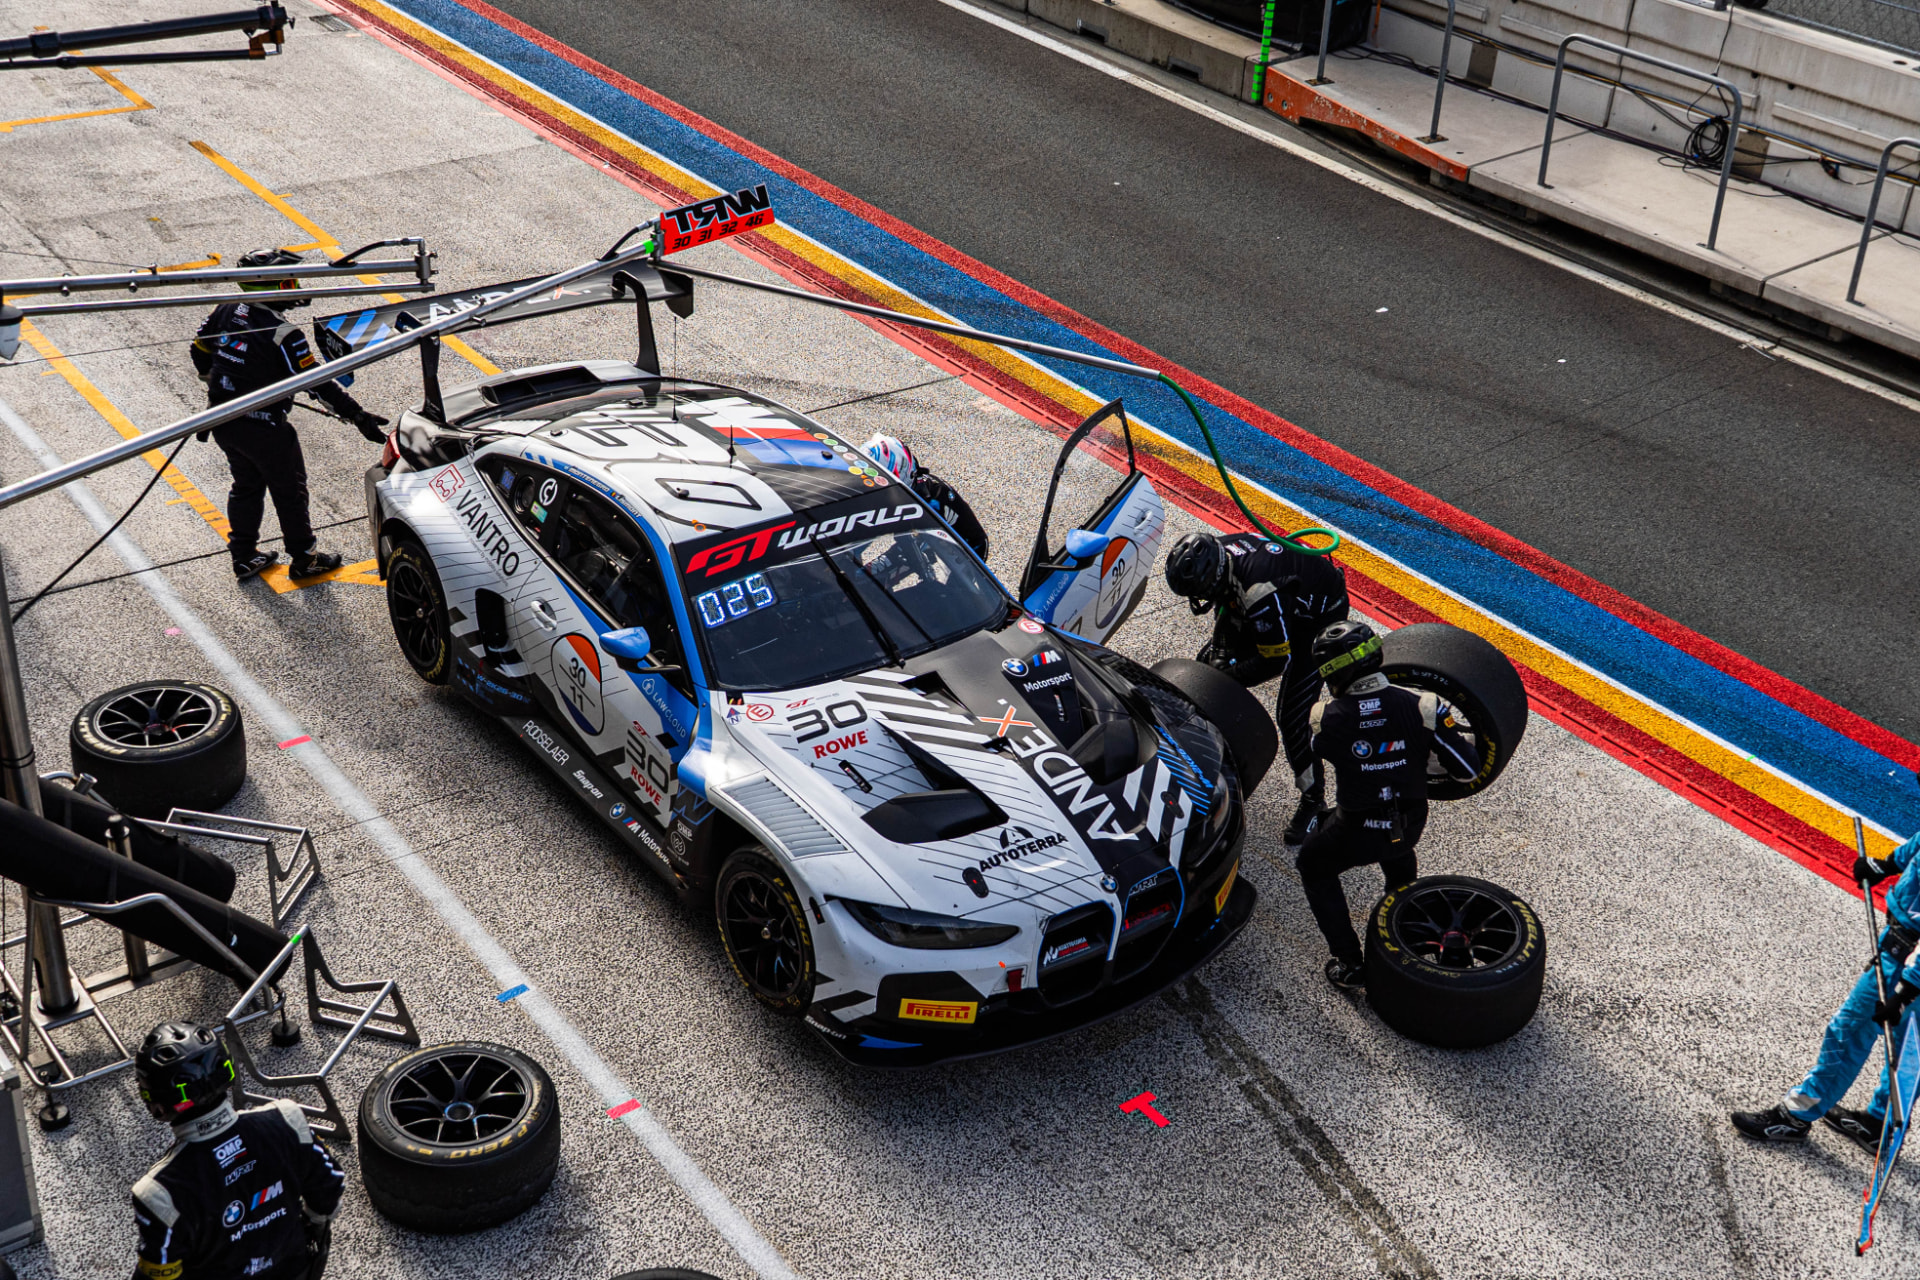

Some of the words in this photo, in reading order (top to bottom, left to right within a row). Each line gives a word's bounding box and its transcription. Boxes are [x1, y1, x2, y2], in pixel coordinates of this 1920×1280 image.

[672, 235, 692, 250] 30
[697, 228, 713, 243] 31
[719, 221, 738, 236] 32
[744, 213, 764, 228] 46
[456, 488, 520, 577] VANTRO
[685, 520, 797, 577] GT
[777, 503, 924, 549] WORLD
[1111, 558, 1126, 586] 30
[698, 572, 775, 628] 025
[568, 657, 587, 689] 30
[1023, 672, 1073, 692] Motorsport
[569, 685, 584, 712] 11
[653, 692, 687, 738] LAWCLOUD
[1358, 700, 1381, 711] OMP
[786, 700, 868, 744] 30
[522, 719, 570, 766] ROOSELAER
[626, 729, 669, 794] 30
[812, 730, 868, 759] ROWE
[1361, 759, 1407, 772] Motorsport
[630, 765, 662, 806] ROWE
[978, 833, 1069, 873] AUTOTERRA
[1377, 895, 1395, 939] ZERO
[1511, 900, 1538, 958] PIRELLI
[906, 1002, 970, 1019] PIRELLI
[215, 1138, 243, 1160] OMP
[449, 1138, 512, 1159] ZERO
